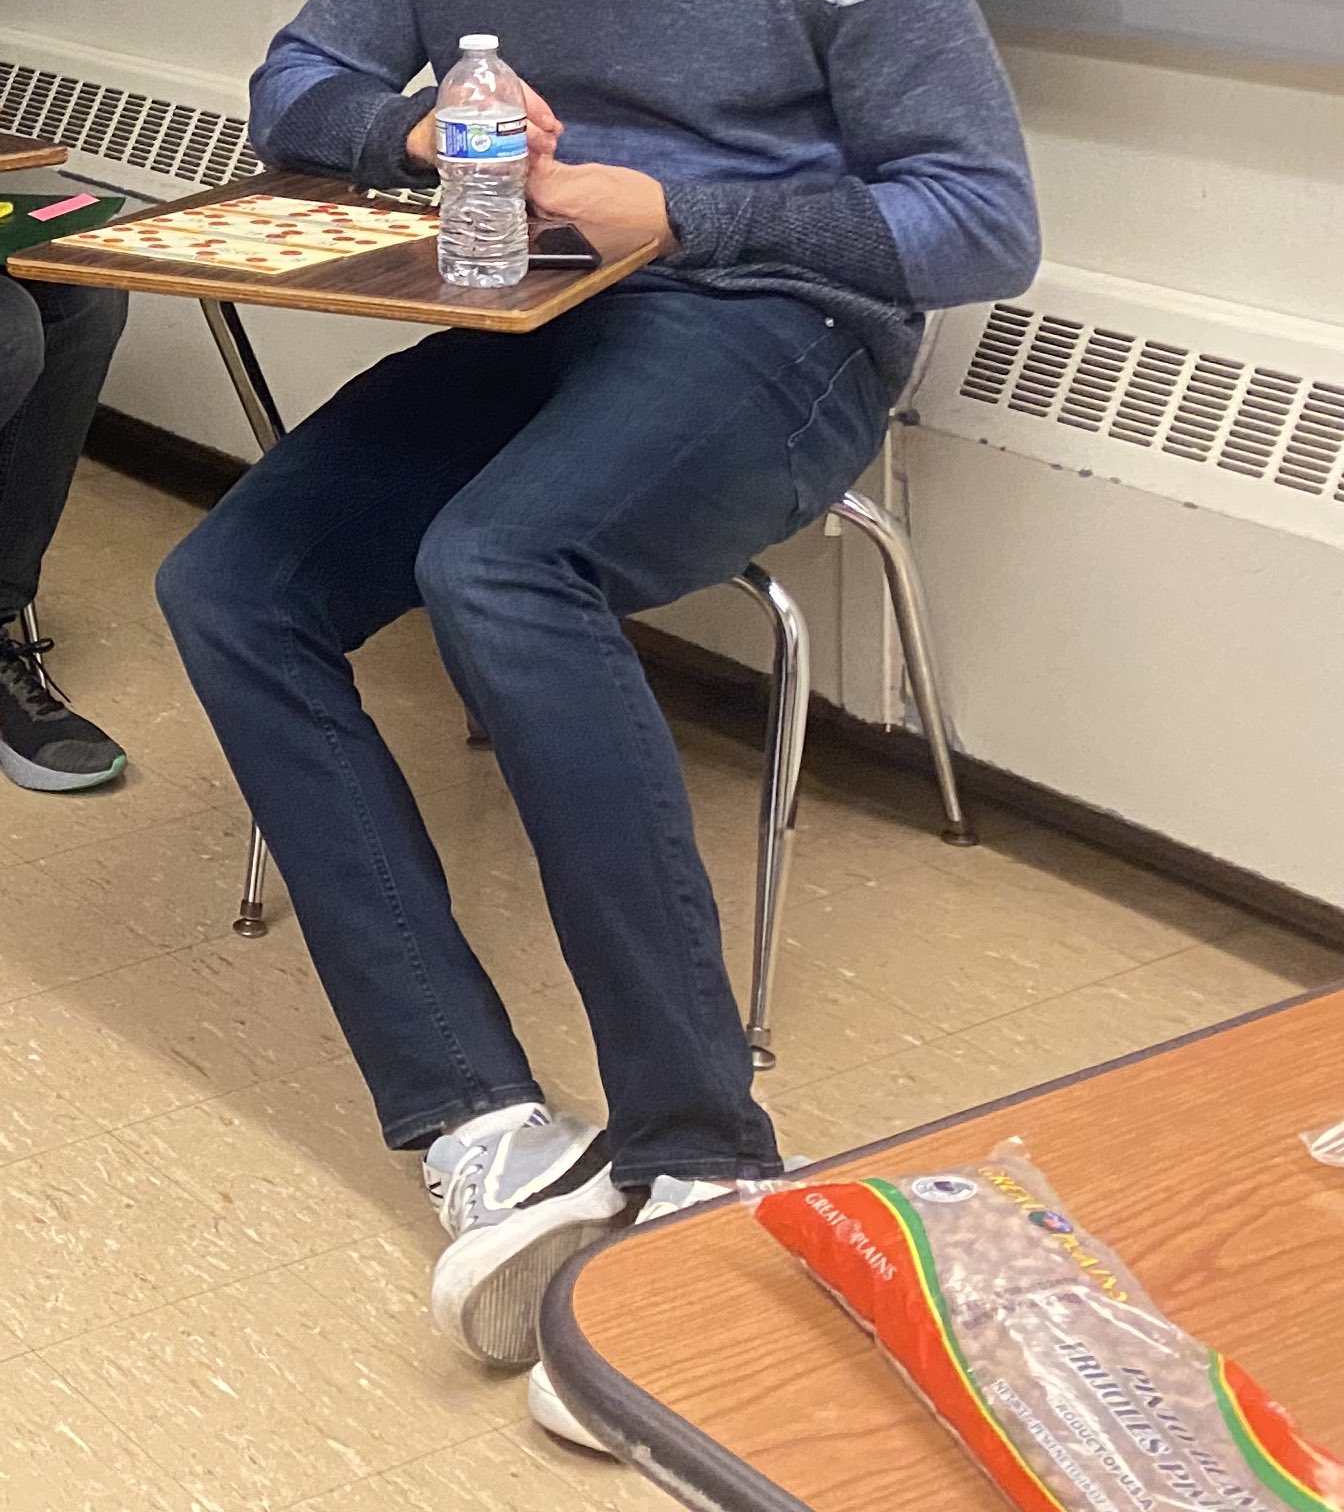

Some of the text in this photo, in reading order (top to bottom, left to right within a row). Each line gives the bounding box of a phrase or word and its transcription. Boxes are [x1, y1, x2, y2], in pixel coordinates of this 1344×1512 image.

[805, 1192, 898, 1281] GREAT PLAINS
[1052, 1400, 1108, 1455] RODUCT
[1056, 1341, 1171, 1455] FRIJOLES
